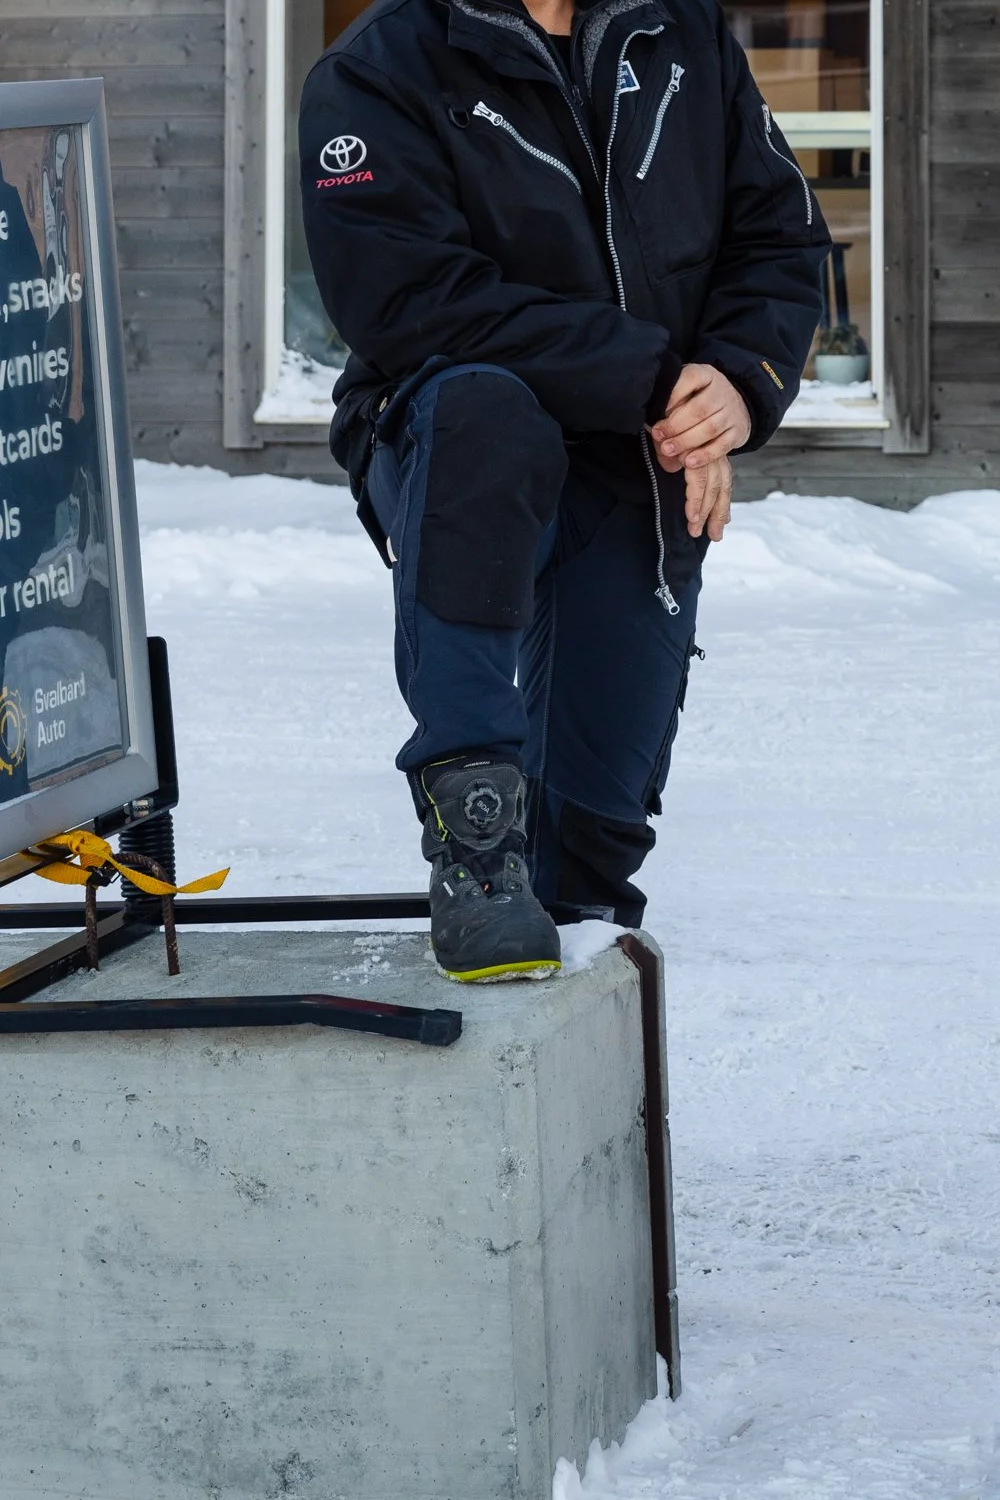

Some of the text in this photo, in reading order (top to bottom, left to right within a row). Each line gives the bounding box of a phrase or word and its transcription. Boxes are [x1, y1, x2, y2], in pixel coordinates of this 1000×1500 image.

[316, 170, 374, 189] TOYOTA
[13, 553, 74, 613] rental
[34, 671, 86, 714] Svalbard
[37, 719, 66, 748] Auto
[476, 800, 490, 814] BOA
